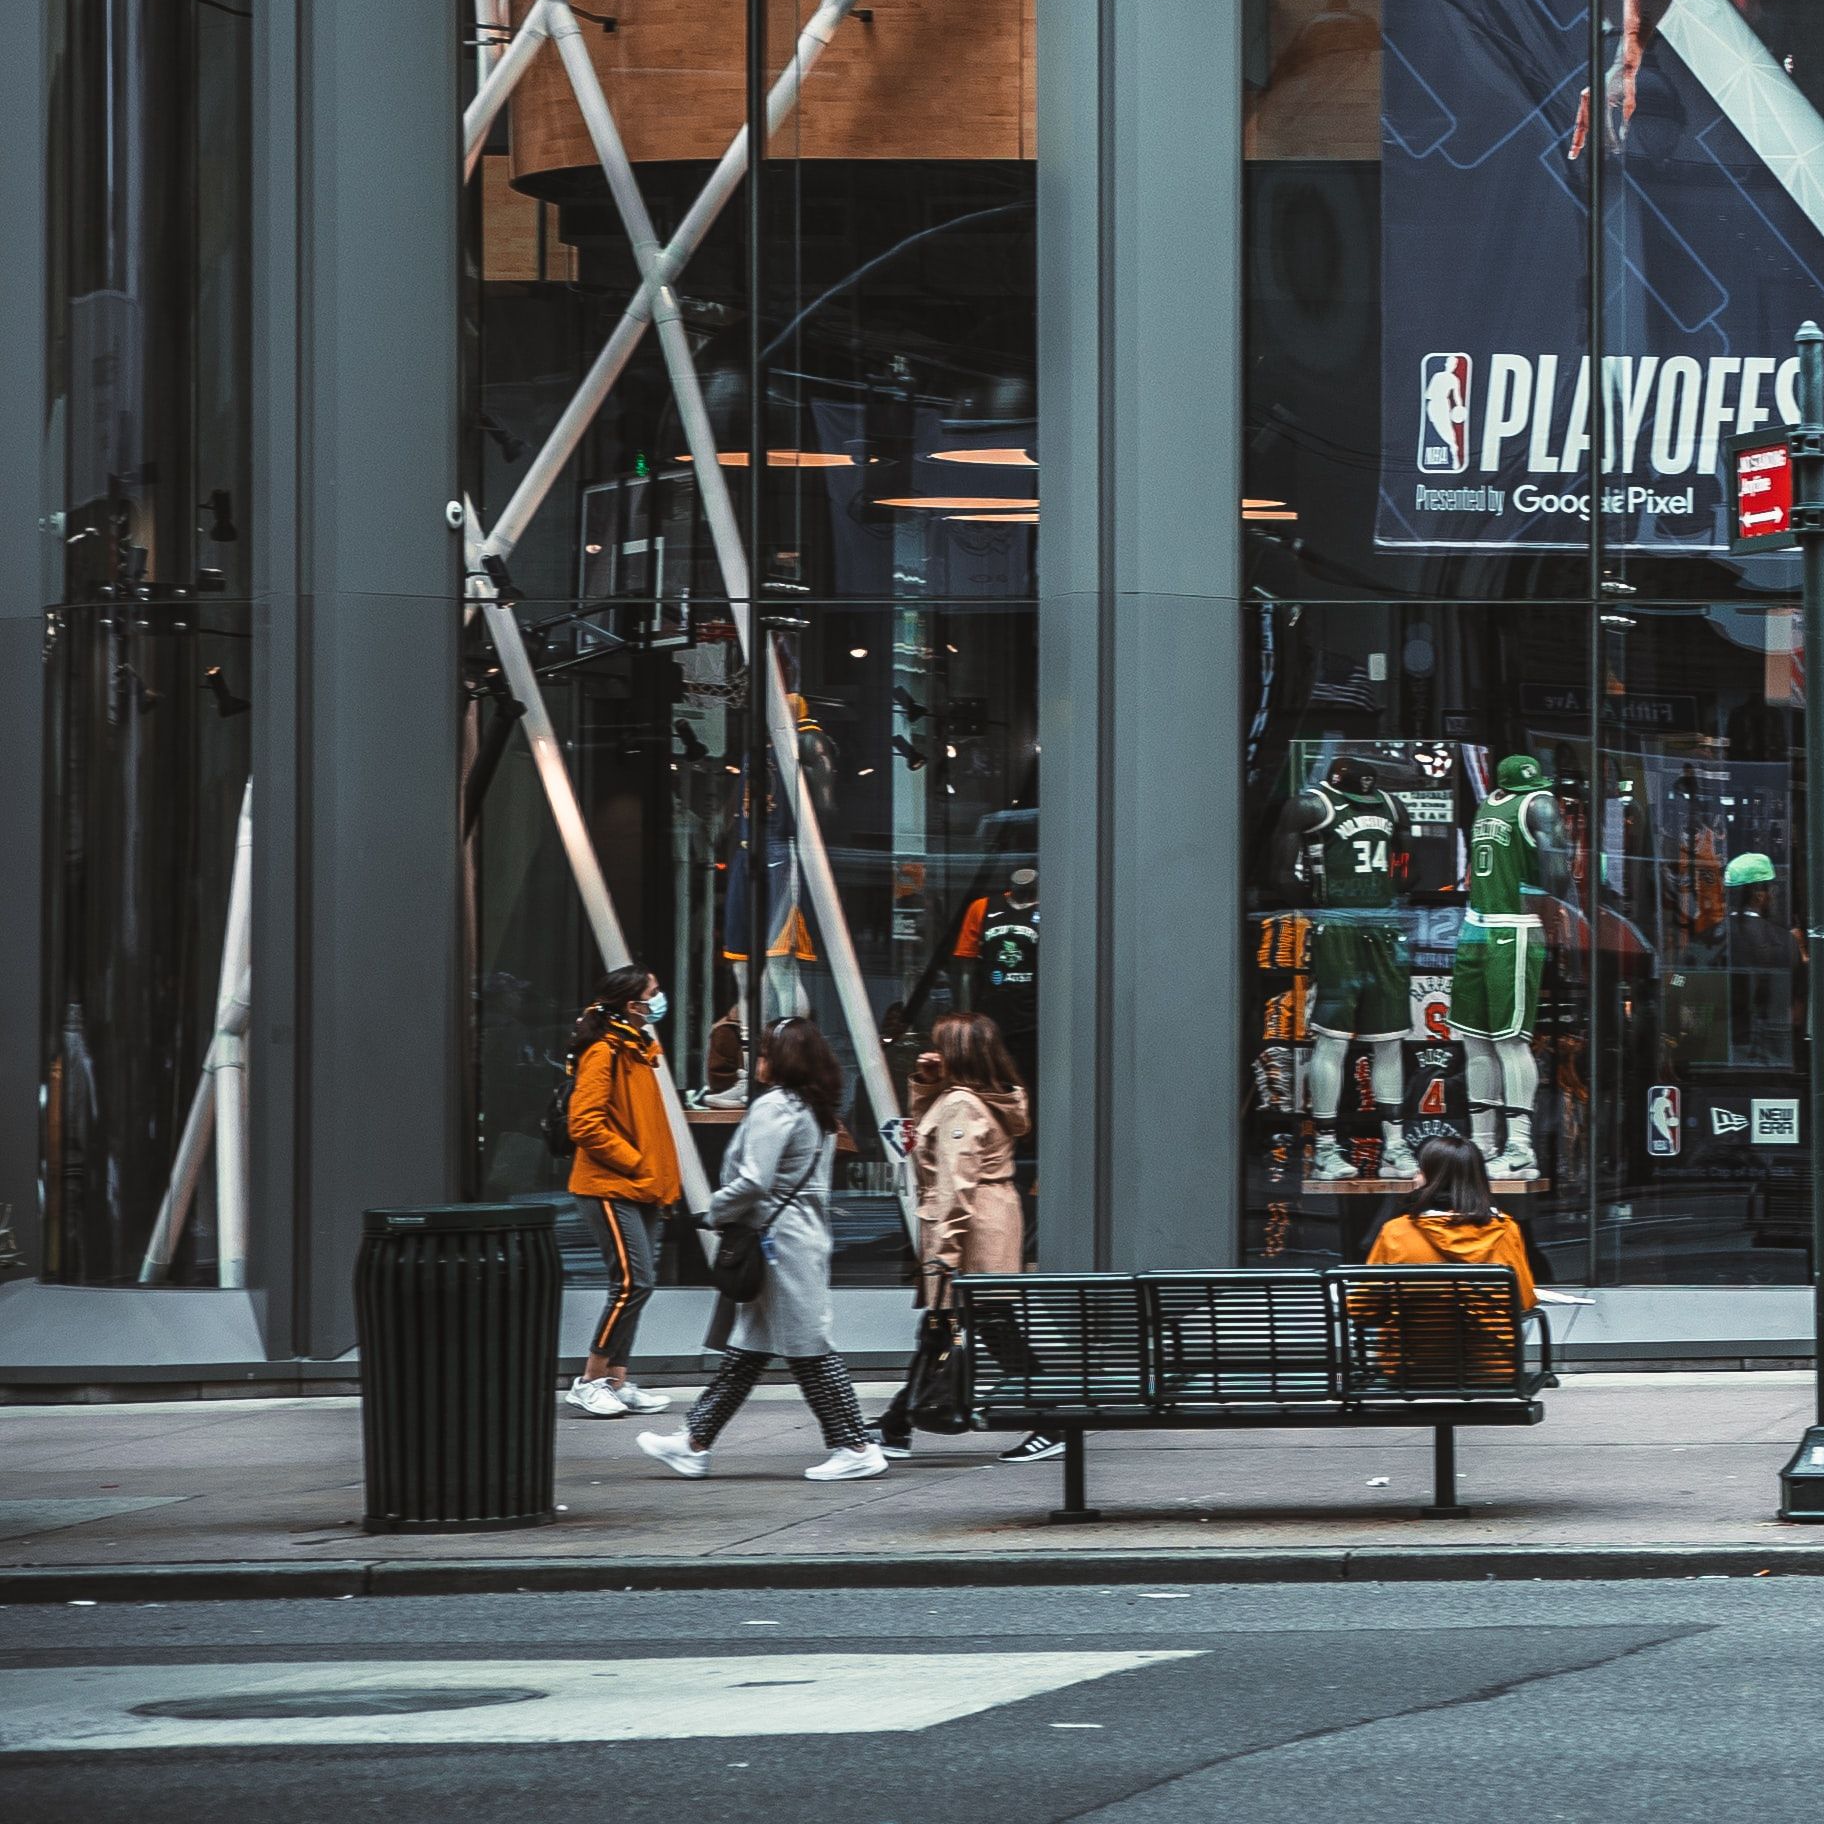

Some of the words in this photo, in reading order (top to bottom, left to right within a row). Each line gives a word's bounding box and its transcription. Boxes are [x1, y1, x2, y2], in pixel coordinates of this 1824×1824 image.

[1415, 484, 1485, 512] Presented
[1488, 484, 1505, 517] by
[1628, 486, 1693, 514] Pixel
[1352, 840, 1388, 873] 34
[1475, 844, 1494, 877] 0
[1418, 1078, 1447, 1115] 4
[1759, 1107, 1793, 1121] NEW
[1759, 1121, 1793, 1134] ERA
